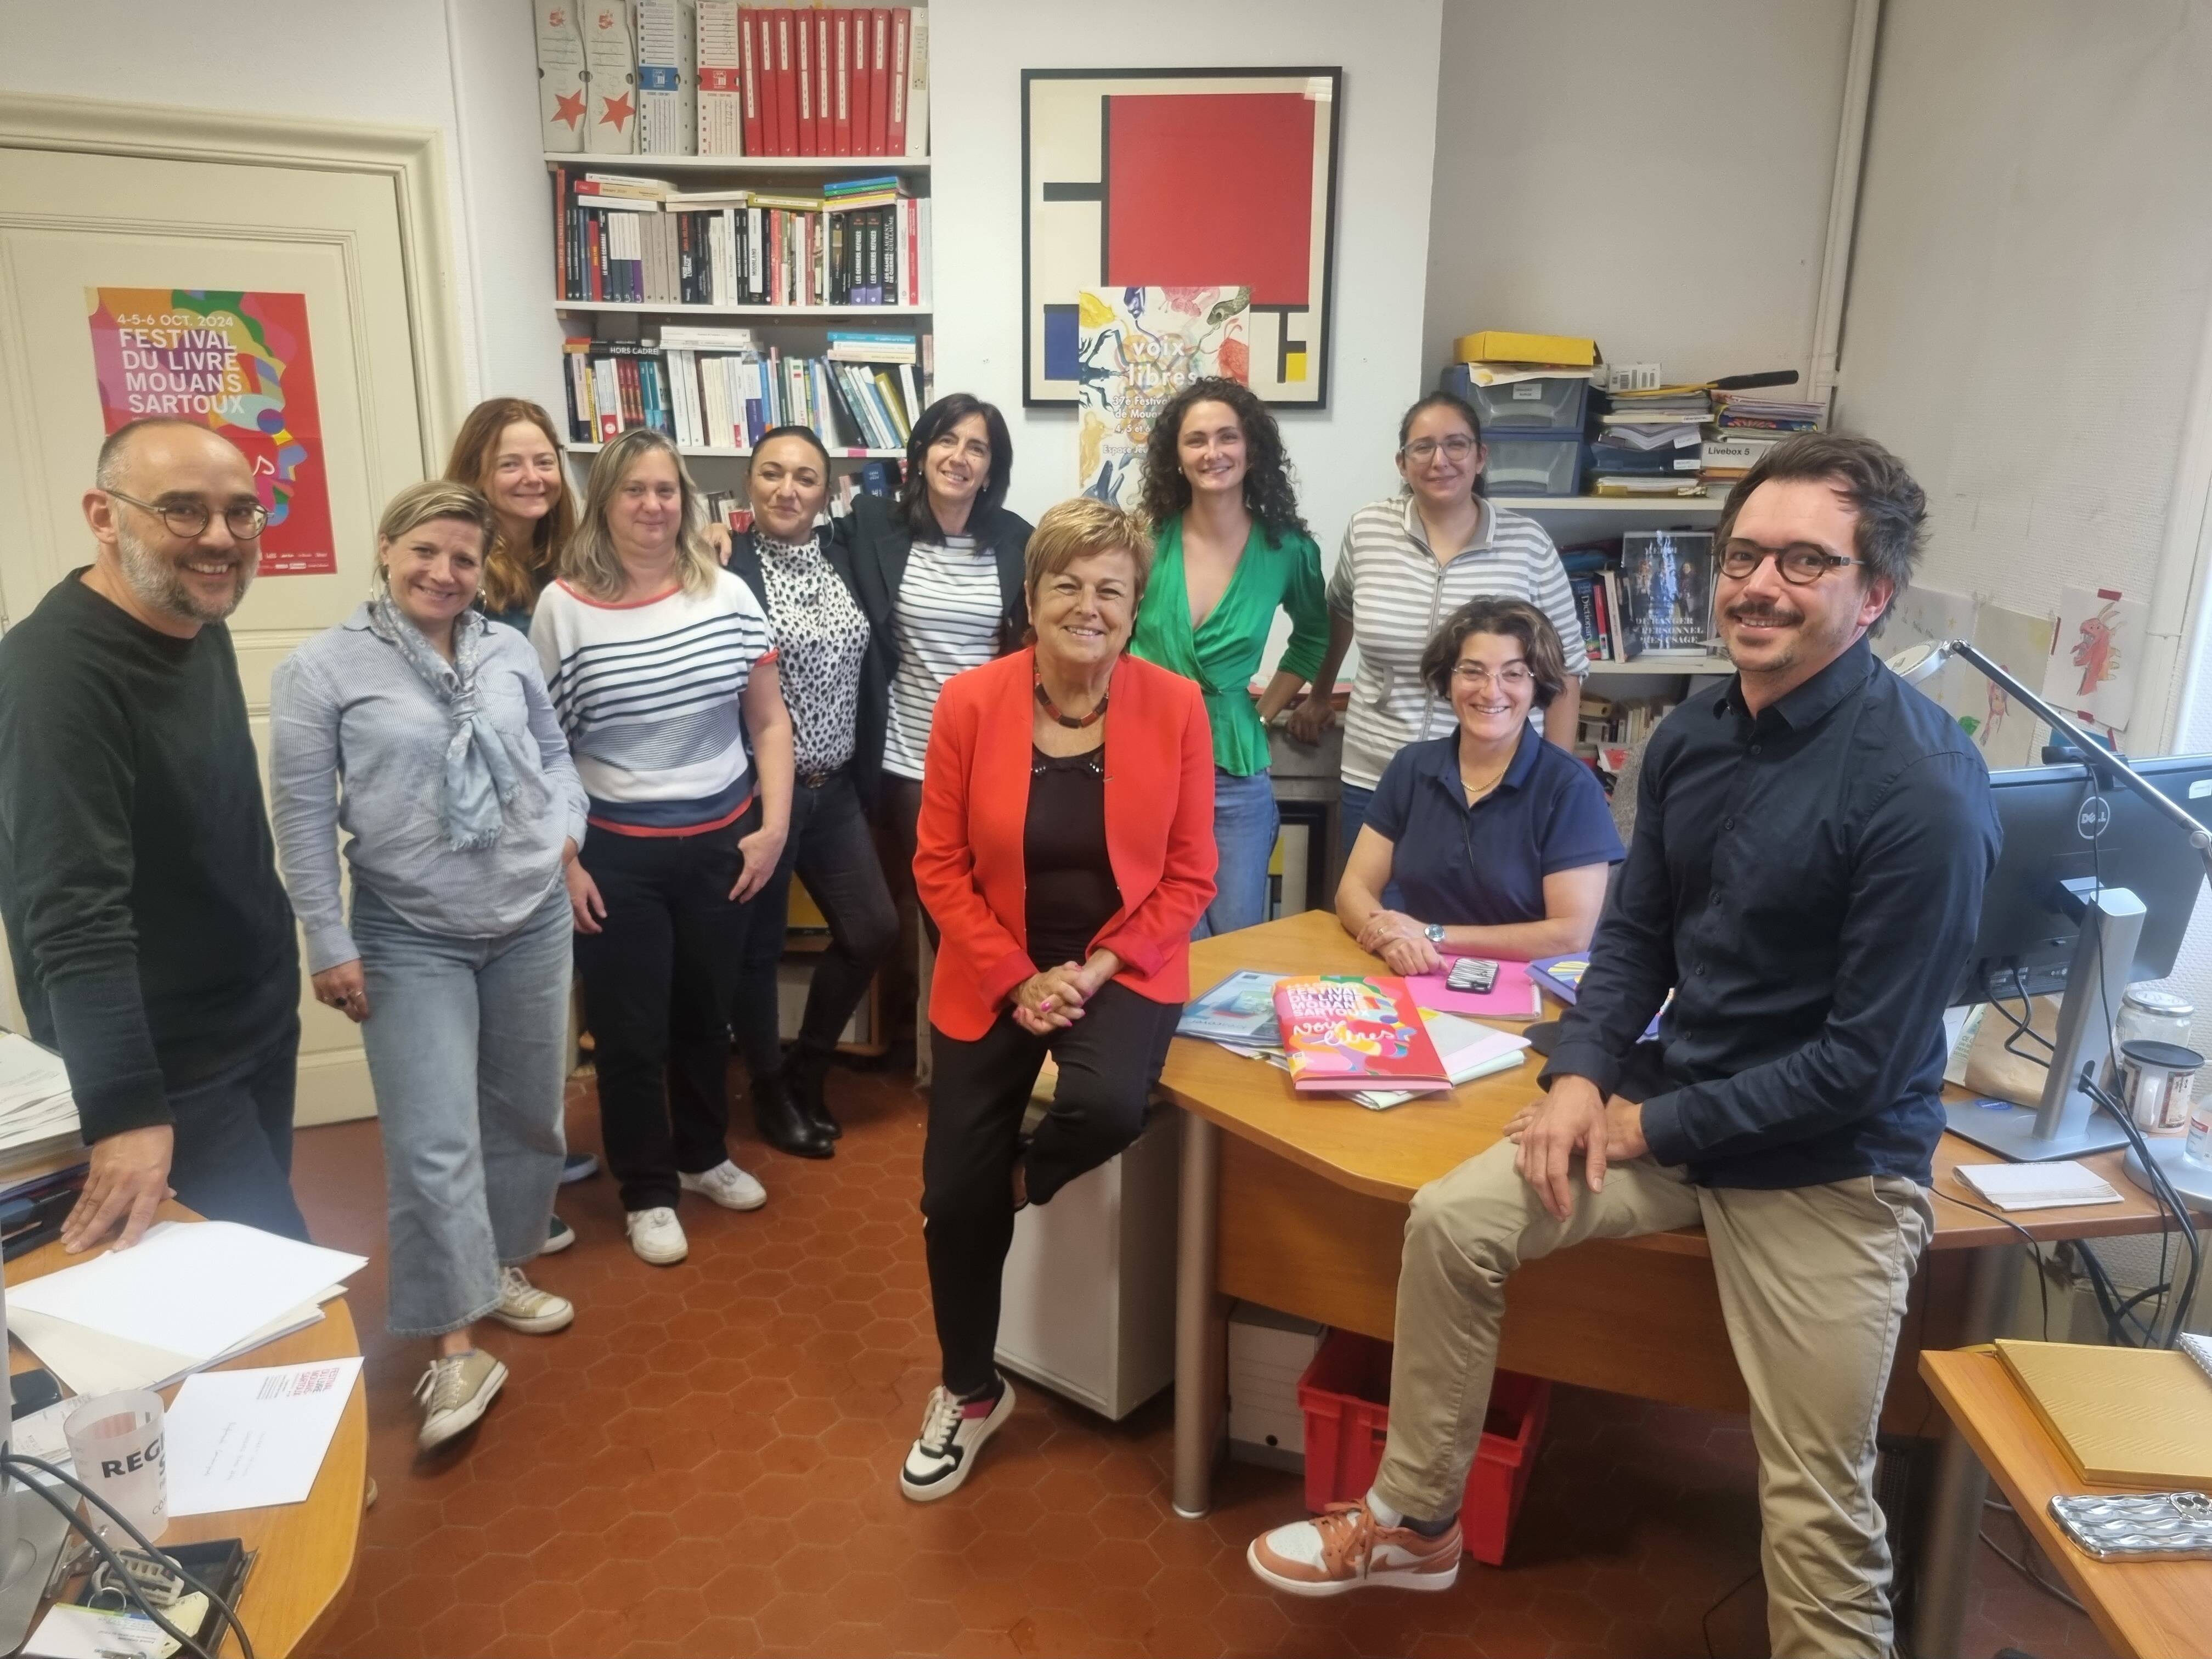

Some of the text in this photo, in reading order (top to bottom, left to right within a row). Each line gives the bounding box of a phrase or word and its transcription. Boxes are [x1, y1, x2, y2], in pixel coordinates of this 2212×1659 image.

[117, 314, 233, 328] 4-5-6 OCT. 2024
[118, 329, 236, 350] FESTIVAL
[1132, 336, 1184, 356] voix
[610, 346, 658, 356] HORS CADRE
[122, 350, 240, 371] DU LIVRE
[1129, 363, 1198, 386] libres
[125, 372, 242, 393] MOUANS
[128, 394, 245, 414] SARTOUX
[1115, 409, 1127, 418] de
[1103, 445, 1132, 455] Espace
[1708, 447, 1741, 455] Livebox
[1581, 595, 1592, 641] Dictionary
[1286, 988, 1361, 996] FESTIVAL
[1289, 994, 1364, 1003] DU LIVRE
[1291, 1001, 1367, 1009] MOUANS
